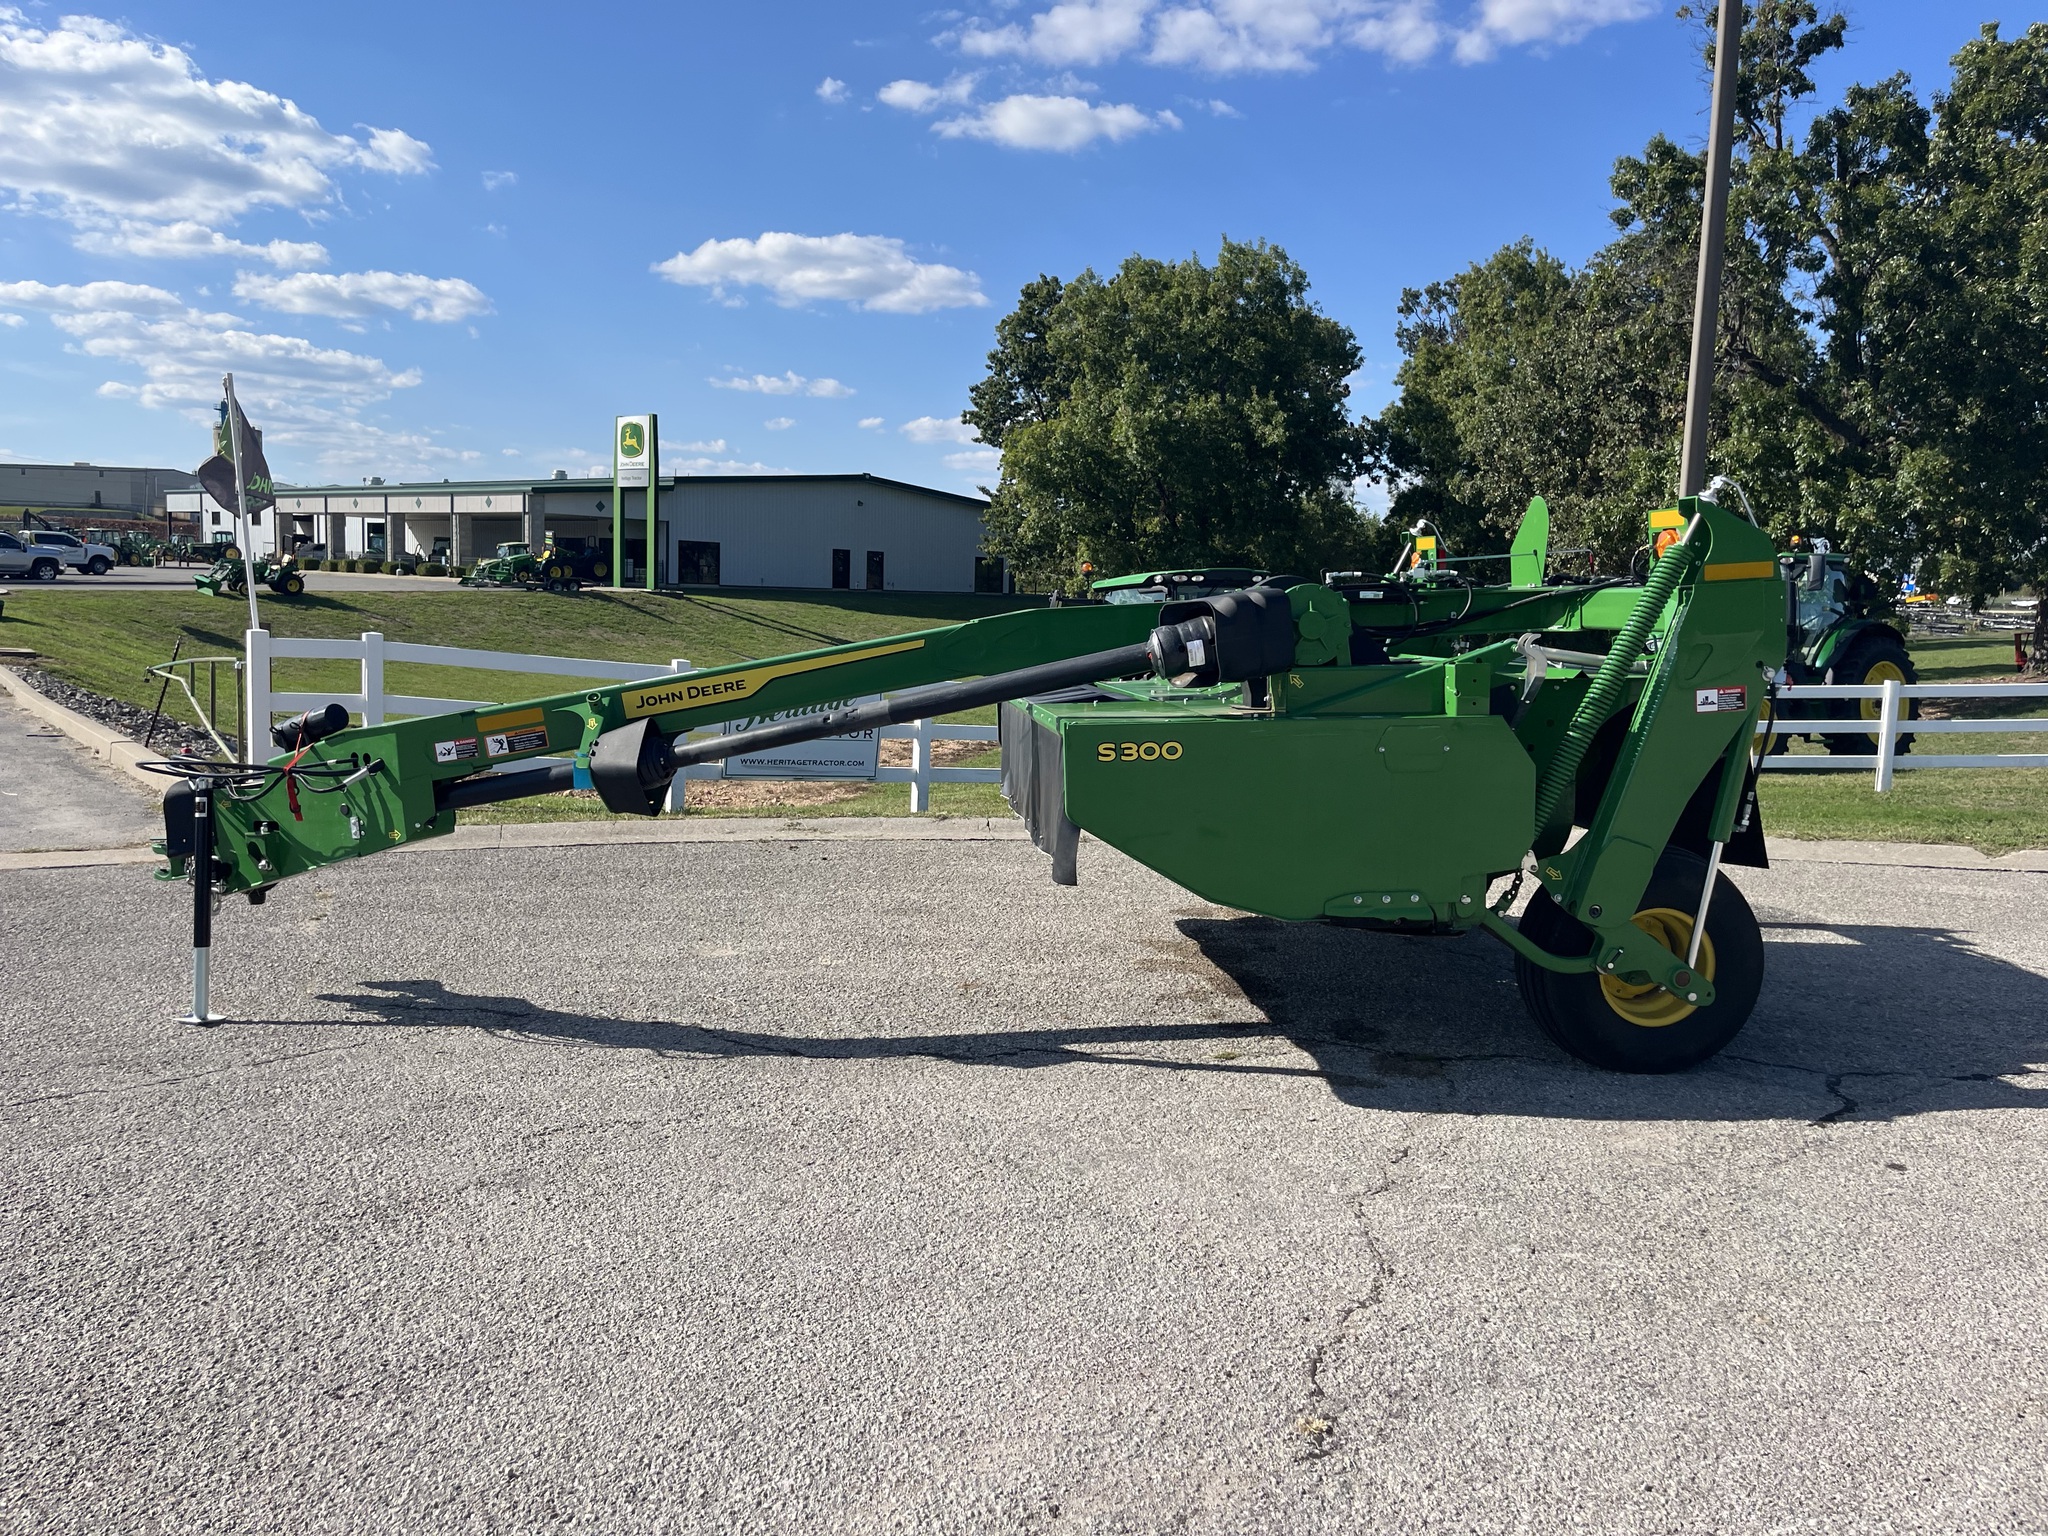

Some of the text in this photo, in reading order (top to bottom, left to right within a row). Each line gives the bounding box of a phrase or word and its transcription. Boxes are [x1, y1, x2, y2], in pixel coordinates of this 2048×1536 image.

[636, 679, 746, 709] JOHN DEERE
[740, 758, 865, 767] WWW.HERITAGETRACTOR.COM
